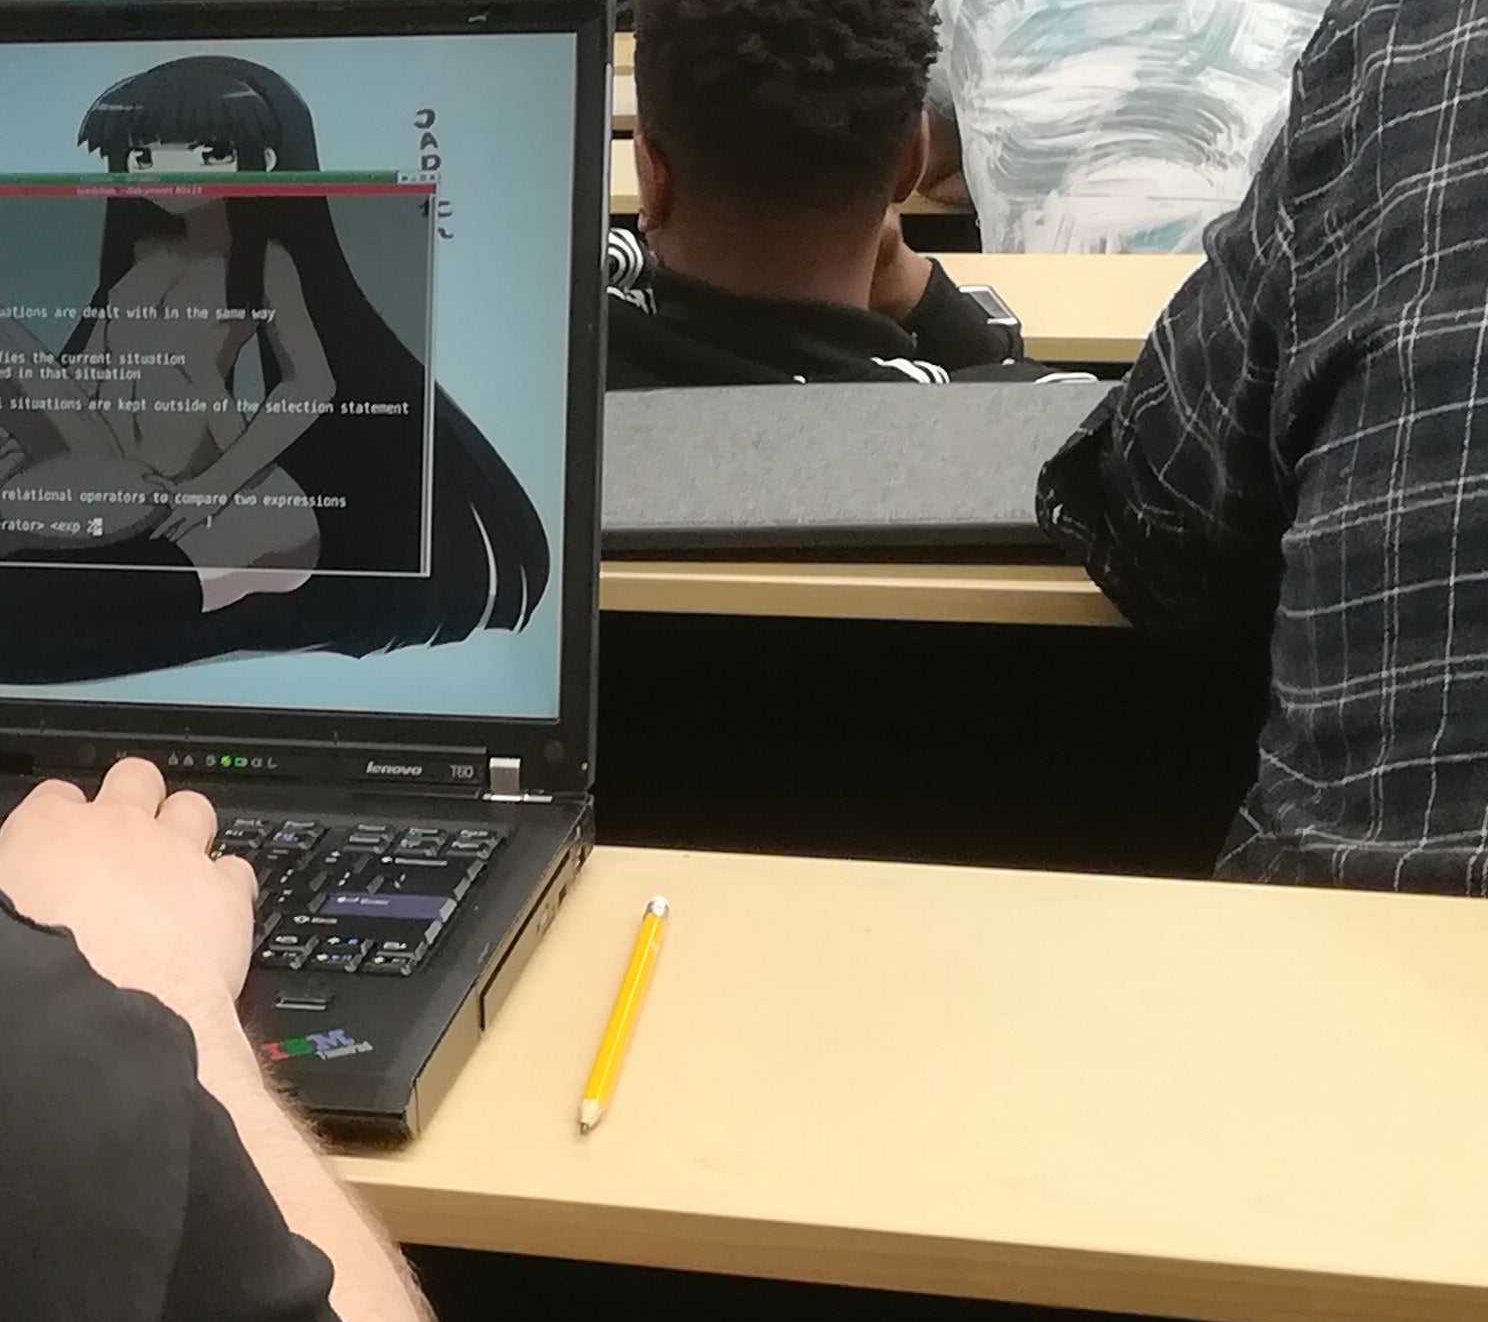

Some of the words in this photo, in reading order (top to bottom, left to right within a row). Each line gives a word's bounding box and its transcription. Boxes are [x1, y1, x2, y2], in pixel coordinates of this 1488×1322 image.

[54, 308, 78, 319] are
[83, 305, 120, 320] dealt
[126, 306, 157, 320] with
[164, 306, 179, 320] in
[186, 306, 209, 320] the
[216, 308, 245, 320] same
[251, 309, 277, 323] way
[32, 350, 58, 364] the
[60, 352, 112, 365] current
[119, 352, 186, 366] situation
[18, 366, 34, 379] in
[39, 367, 67, 380] that
[74, 367, 142, 381] situation
[10, 397, 82, 411] situations
[88, 400, 112, 411] are
[117, 398, 146, 413] kept
[154, 398, 207, 413] outside
[212, 399, 228, 412] of
[236, 399, 262, 413] the
[265, 399, 334, 414] selection
[340, 399, 409, 415] statement
[1, 488, 73, 502] relational
[79, 491, 146, 505] operators
[153, 492, 168, 505] to
[174, 492, 227, 507] compare
[233, 493, 257, 506] two
[263, 494, 347, 508] expressions
[49, 520, 81, 534] <exp
[365, 761, 423, 776] lenovo
[449, 764, 475, 779] T60
